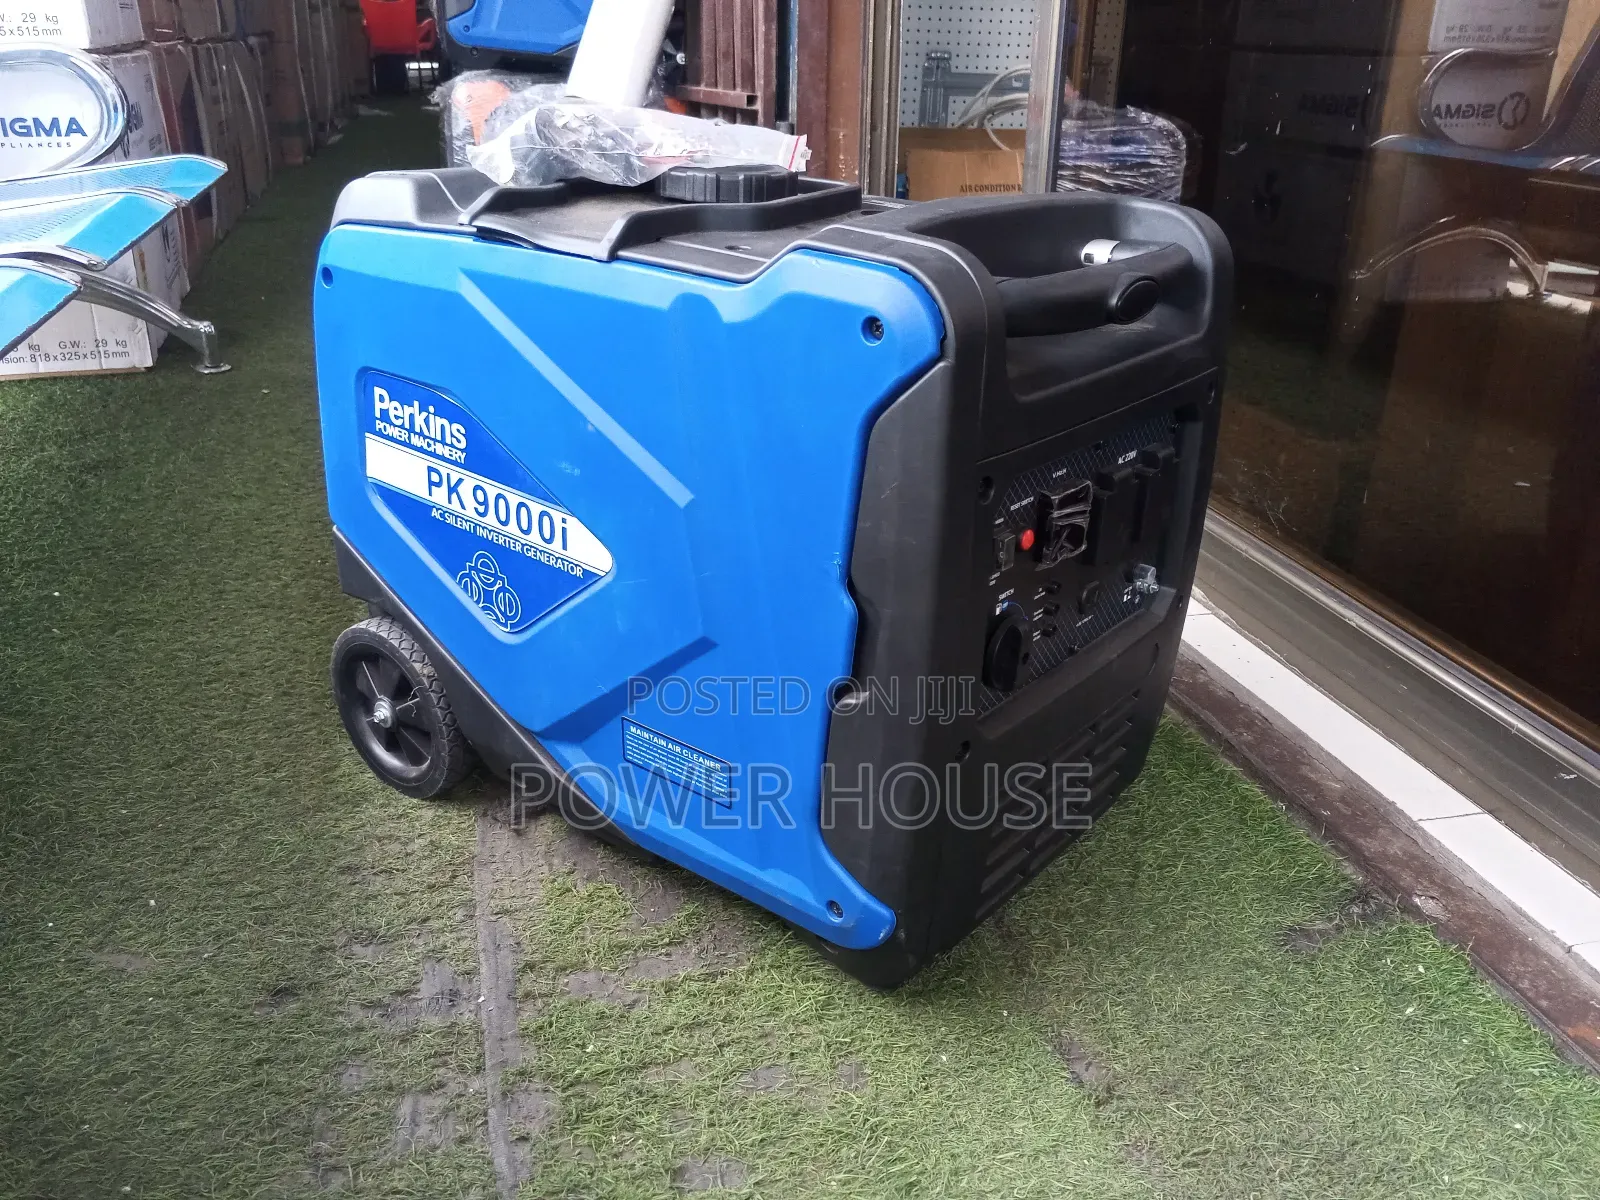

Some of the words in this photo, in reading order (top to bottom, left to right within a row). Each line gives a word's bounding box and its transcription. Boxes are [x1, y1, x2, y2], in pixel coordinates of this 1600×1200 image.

[21, 12, 37, 23] 29
[45, 13, 59, 25] kg
[960, 183, 973, 193] AIR
[28, 342, 41, 353] kg
[58, 340, 86, 350] G.W.:
[94, 338, 108, 349] 29
[115, 338, 128, 348] kg
[373, 386, 467, 450] Perkins
[375, 420, 409, 444] POWER
[410, 433, 467, 465] MACHINERY
[430, 506, 444, 522] AC
[444, 511, 475, 535] SILENT
[476, 524, 522, 554] INVERTER
[523, 544, 584, 579] GENERATOR
[630, 725, 667, 748] MAINTAIN
[668, 742, 682, 754] AIR
[682, 749, 722, 771] CLEANER
